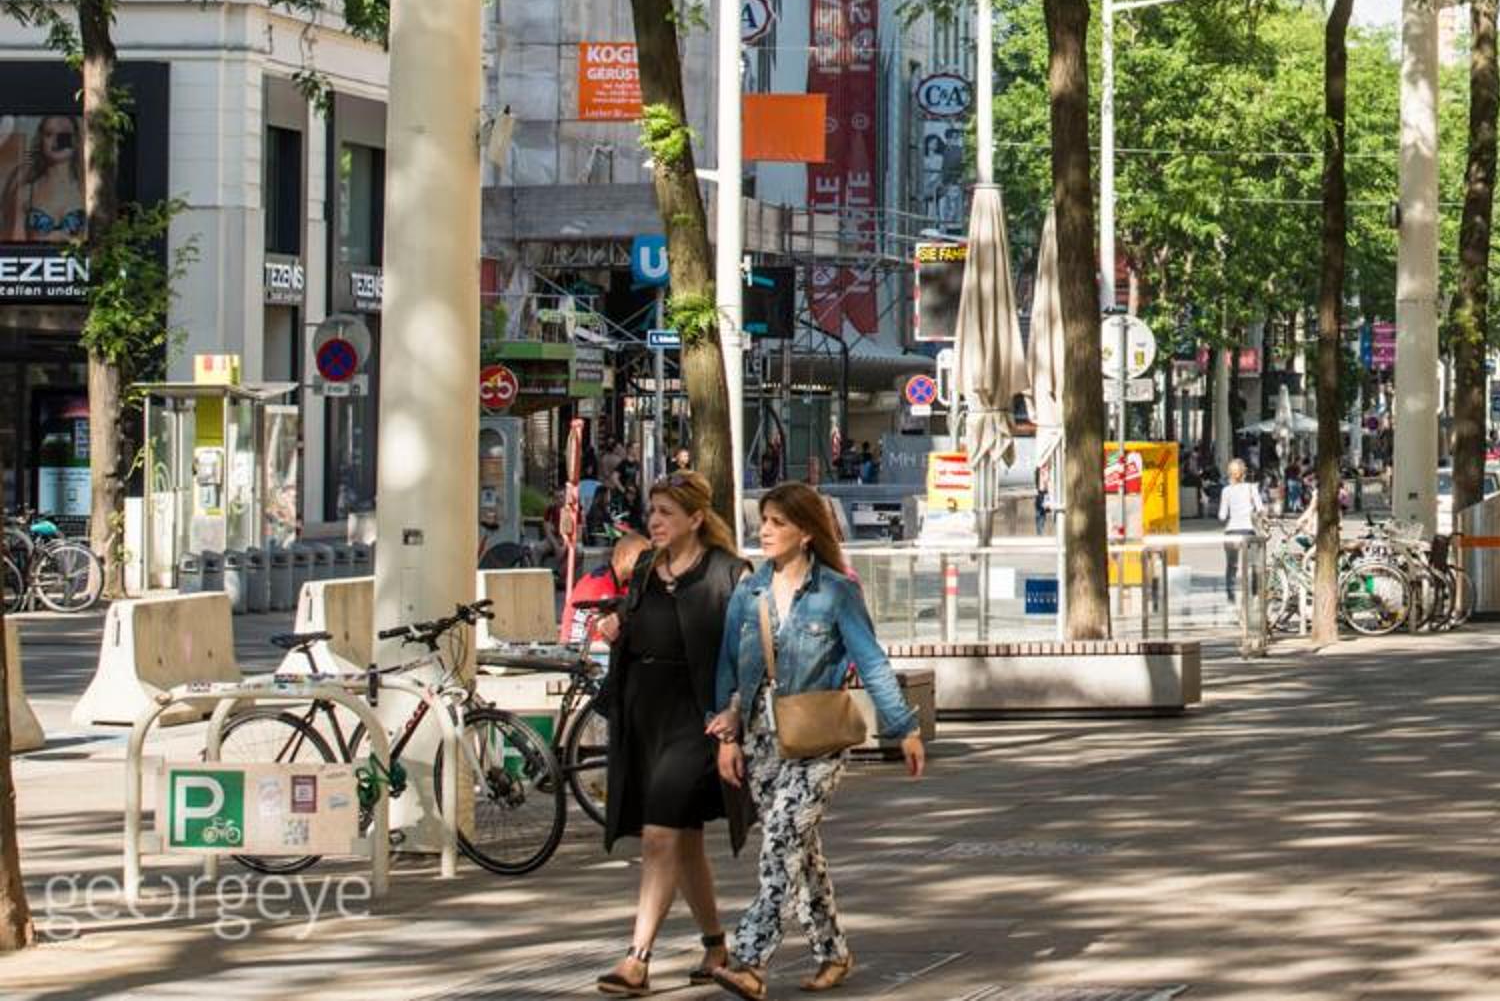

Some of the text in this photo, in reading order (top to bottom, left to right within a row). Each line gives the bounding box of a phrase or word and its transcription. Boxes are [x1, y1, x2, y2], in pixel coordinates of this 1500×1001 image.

[924, 84, 967, 108] C&A
[640, 247, 668, 278] U
[175, 776, 225, 842] P
